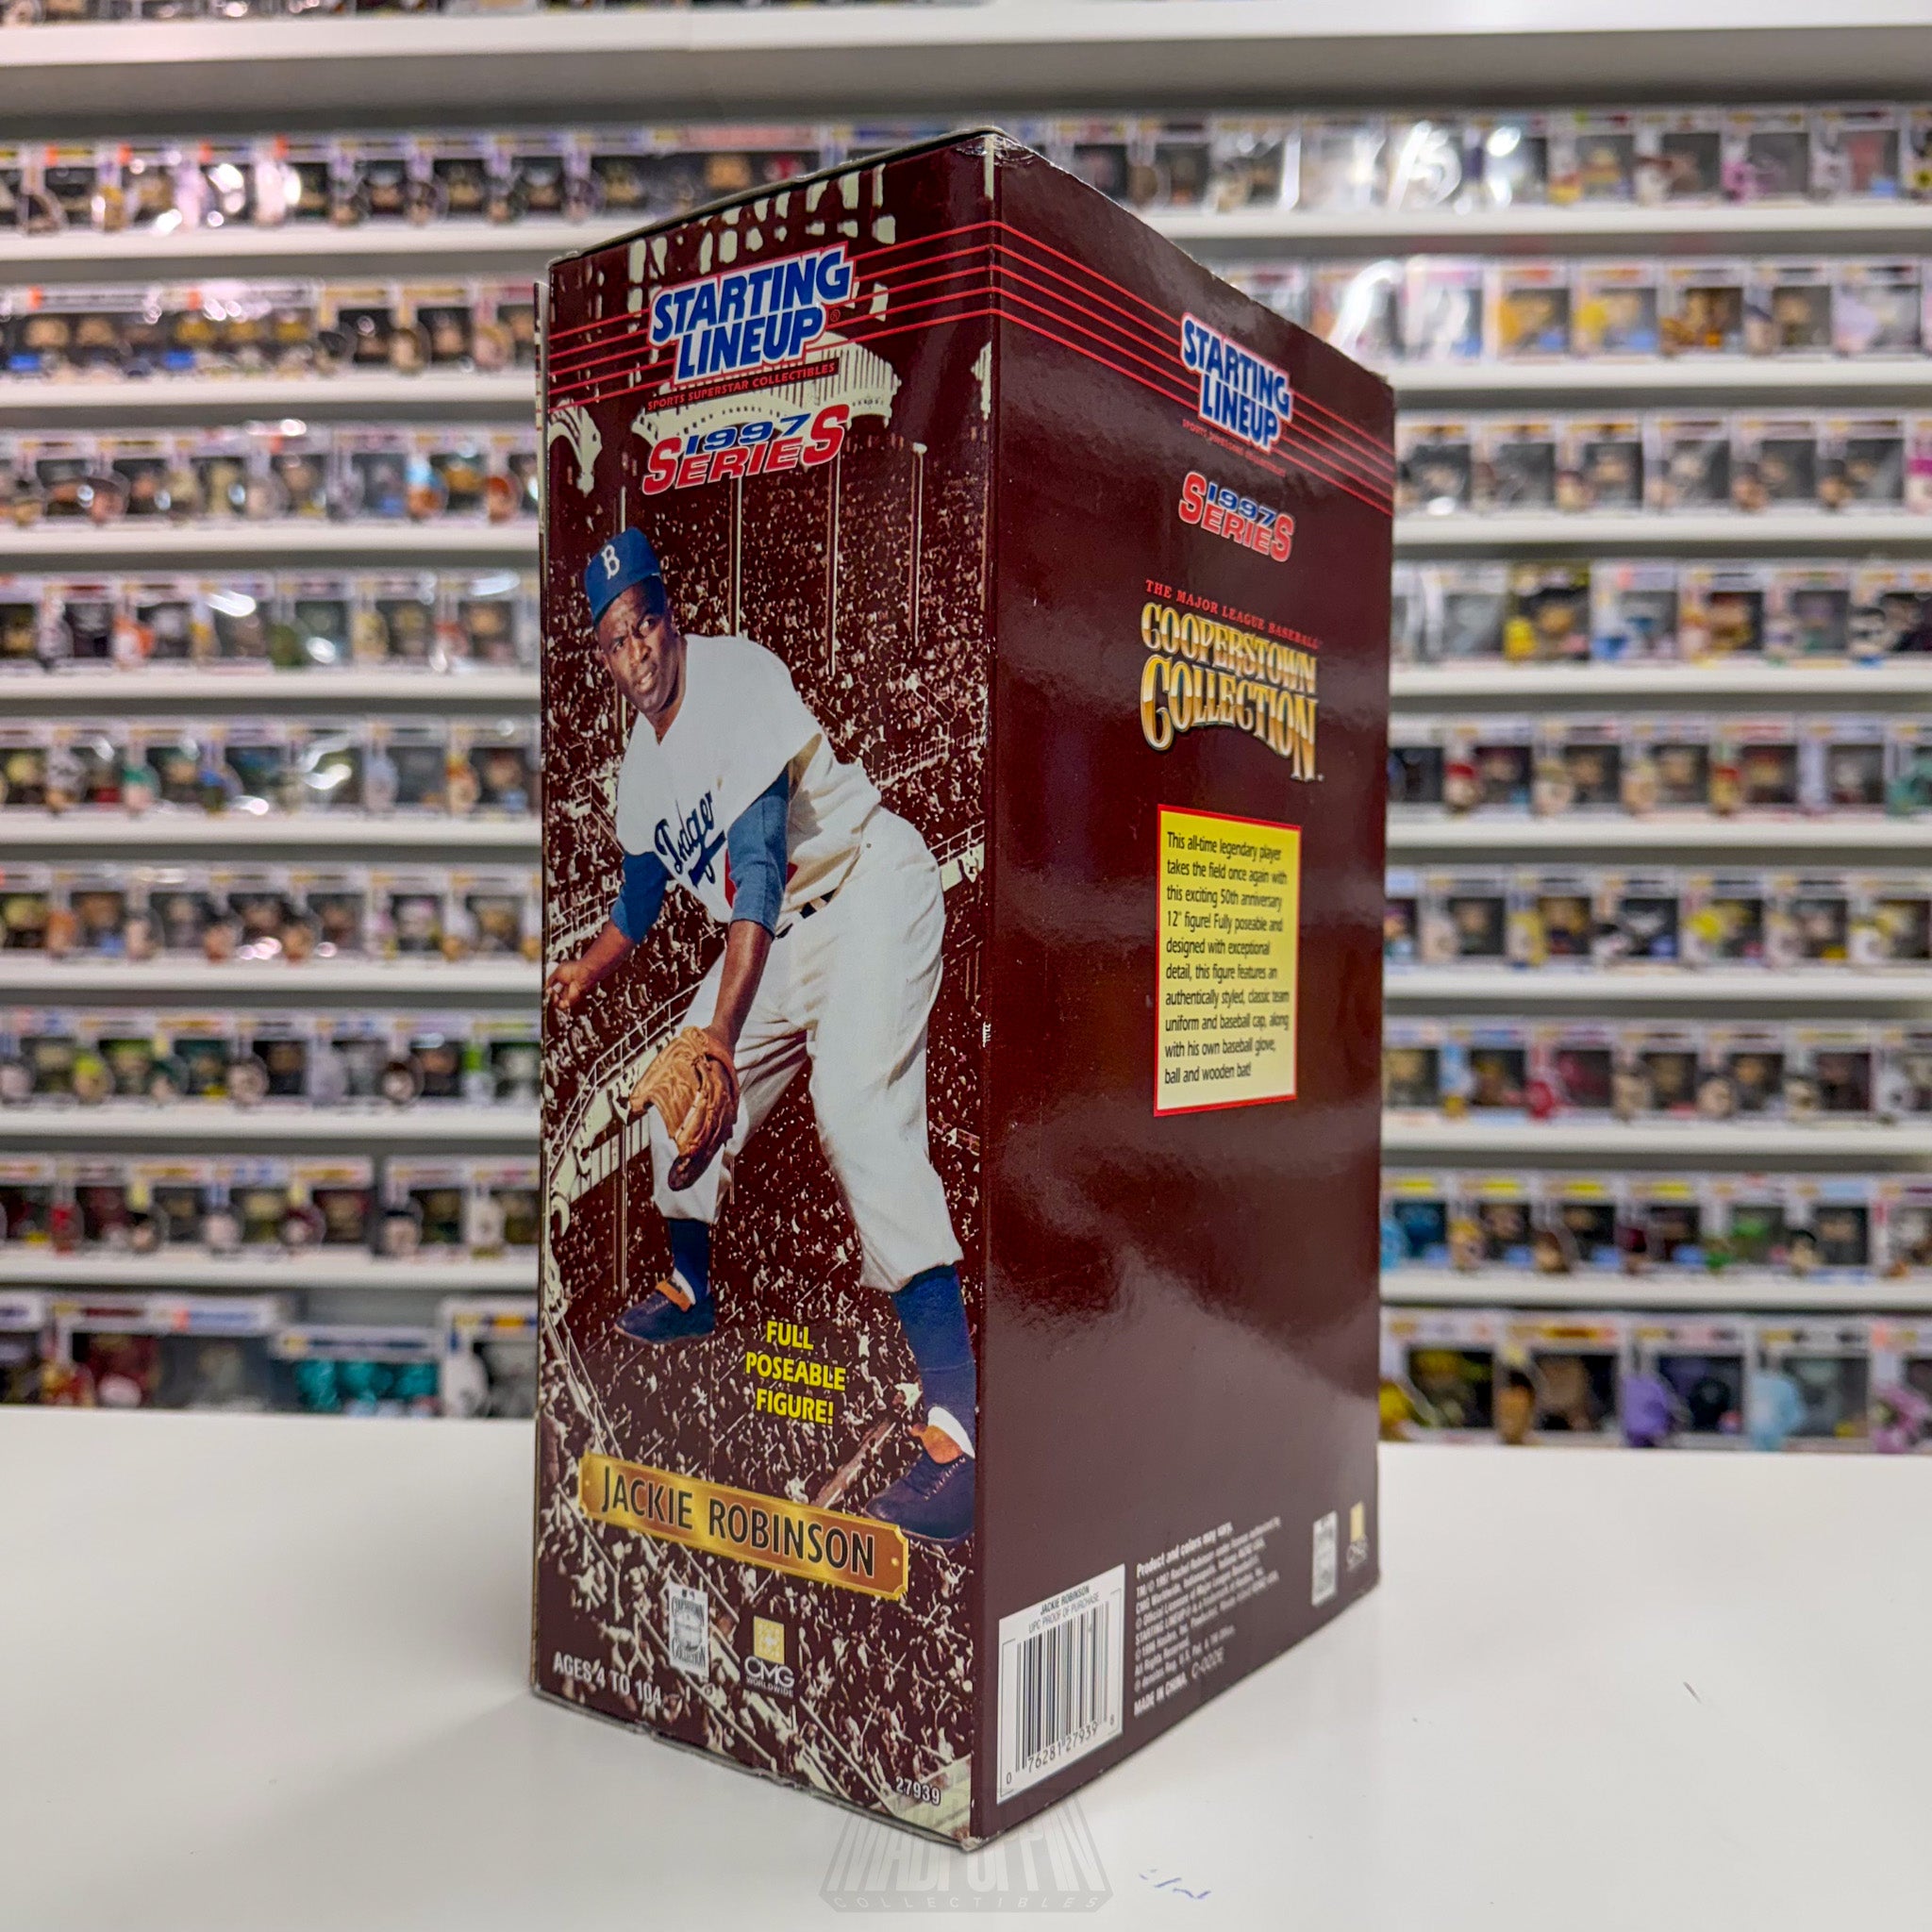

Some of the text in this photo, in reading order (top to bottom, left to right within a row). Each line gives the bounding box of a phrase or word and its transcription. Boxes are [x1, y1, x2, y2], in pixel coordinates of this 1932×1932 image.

[650, 245, 851, 343] STARTING
[675, 306, 825, 381] LINEUP
[647, 362, 836, 409] SPORTS SUPERSTAR COLLECTIBLES
[1182, 319, 1291, 419] STARTING
[1201, 374, 1279, 448] LINEUP
[642, 404, 849, 494] SERIES
[686, 413, 811, 455] 1997
[1179, 472, 1294, 562] SERIES
[1207, 482, 1276, 527] 1997
[601, 544, 620, 579] B
[1145, 579, 1319, 650] THE MAJOR LEAGUE BASEBALL
[1141, 602, 1318, 695] COOPERSTOWN
[1141, 654, 1319, 782] COLLECTION
[1167, 831, 1282, 864] This all-time legendary player
[1167, 859, 1288, 887] takes the field once again with
[1167, 885, 1283, 913] this exciting 50th anniversary
[1184, 911, 1211, 933] figure!
[1213, 913, 1232, 934] Fully
[1234, 916, 1268, 935] poseable
[1269, 918, 1284, 932] and
[1166, 937, 1271, 959] designed with exceptional
[1166, 964, 1277, 984] detail, this figure features an
[1166, 989, 1220, 1009] authentically
[1165, 1015, 1199, 1031] uniform
[1202, 1014, 1218, 1030] and
[1220, 1013, 1251, 1030] baseball
[1165, 1041, 1185, 1058] with
[1187, 1041, 1199, 1057] his
[1202, 1041, 1220, 1056] own
[1223, 1038, 1254, 1055] baseball
[1164, 1067, 1180, 1085] ball
[1183, 1066, 1200, 1083] and
[1202, 1064, 1235, 1081] wooden
[766, 1320, 814, 1351] FULL
[745, 1351, 847, 1392] POSEABLE
[756, 1389, 835, 1425] FIGURE!
[601, 1465, 875, 1578] JACKIE ROBINSON
[553, 1651, 592, 1684] AGES
[596, 1666, 607, 1690] 4
[609, 1669, 631, 1696] TO
[743, 1656, 795, 1689] CMG
[745, 1674, 794, 1698] WORLDWIDE
[1006, 1772, 1012, 1785] 0
[1027, 1741, 1062, 1774] 76281
[1066, 1721, 1099, 1754] 27939
[895, 1776, 941, 1806] 27939
